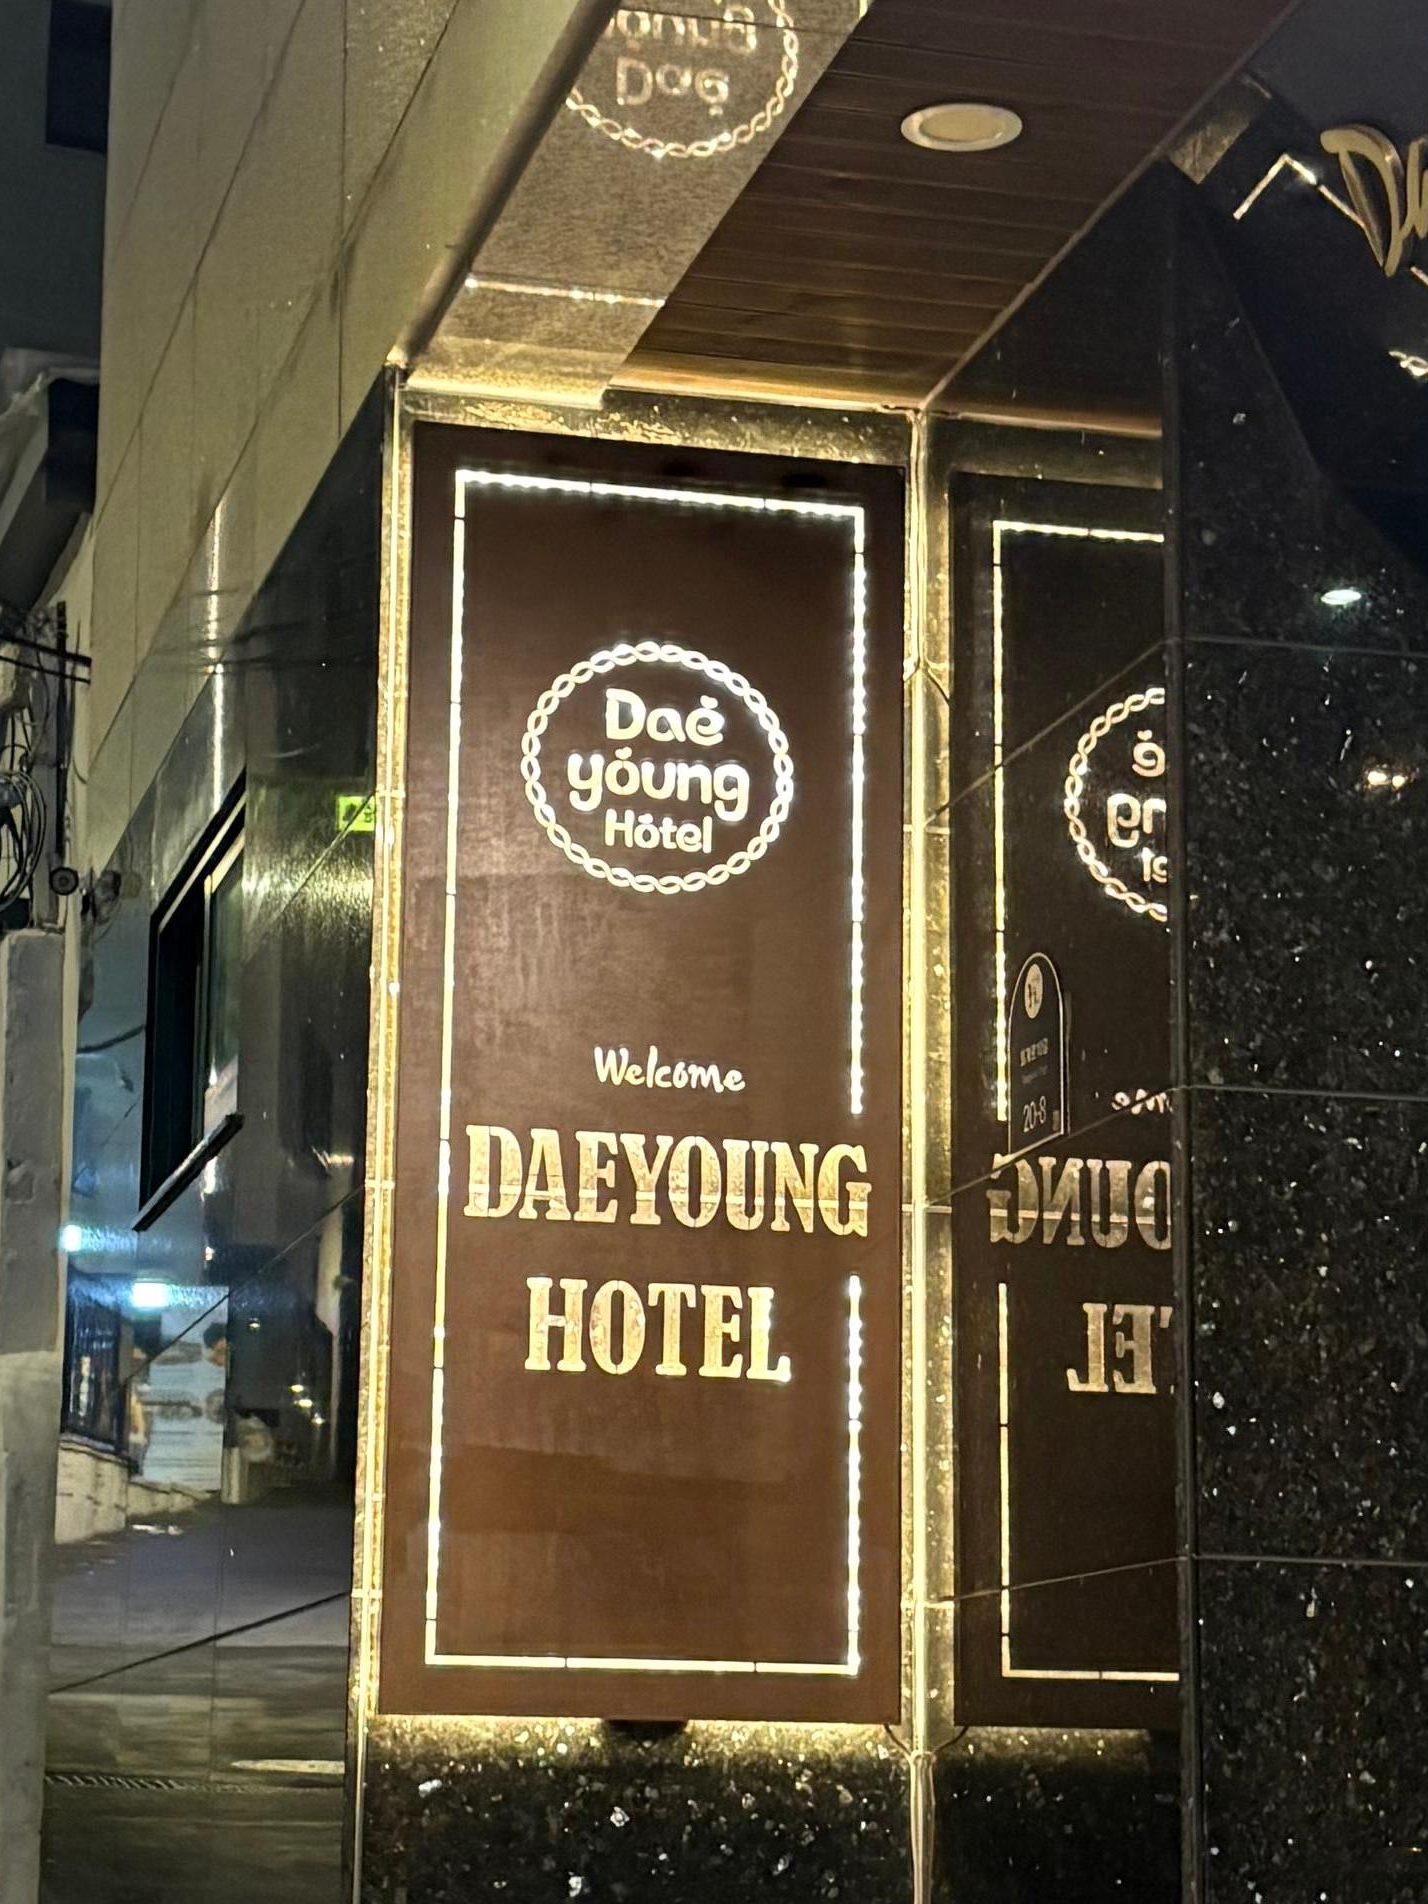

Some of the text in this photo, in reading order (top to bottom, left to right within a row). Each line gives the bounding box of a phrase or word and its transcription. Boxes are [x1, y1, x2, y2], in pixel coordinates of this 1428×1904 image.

[605, 688, 725, 746] Dae
[566, 747, 750, 822] young
[604, 808, 713, 854] Hotel
[593, 1045, 746, 1093] Welcome
[1023, 1096, 1047, 1134] 20-8
[463, 1124, 872, 1237] DAEYOUNG
[524, 1277, 792, 1383] HOTEL
